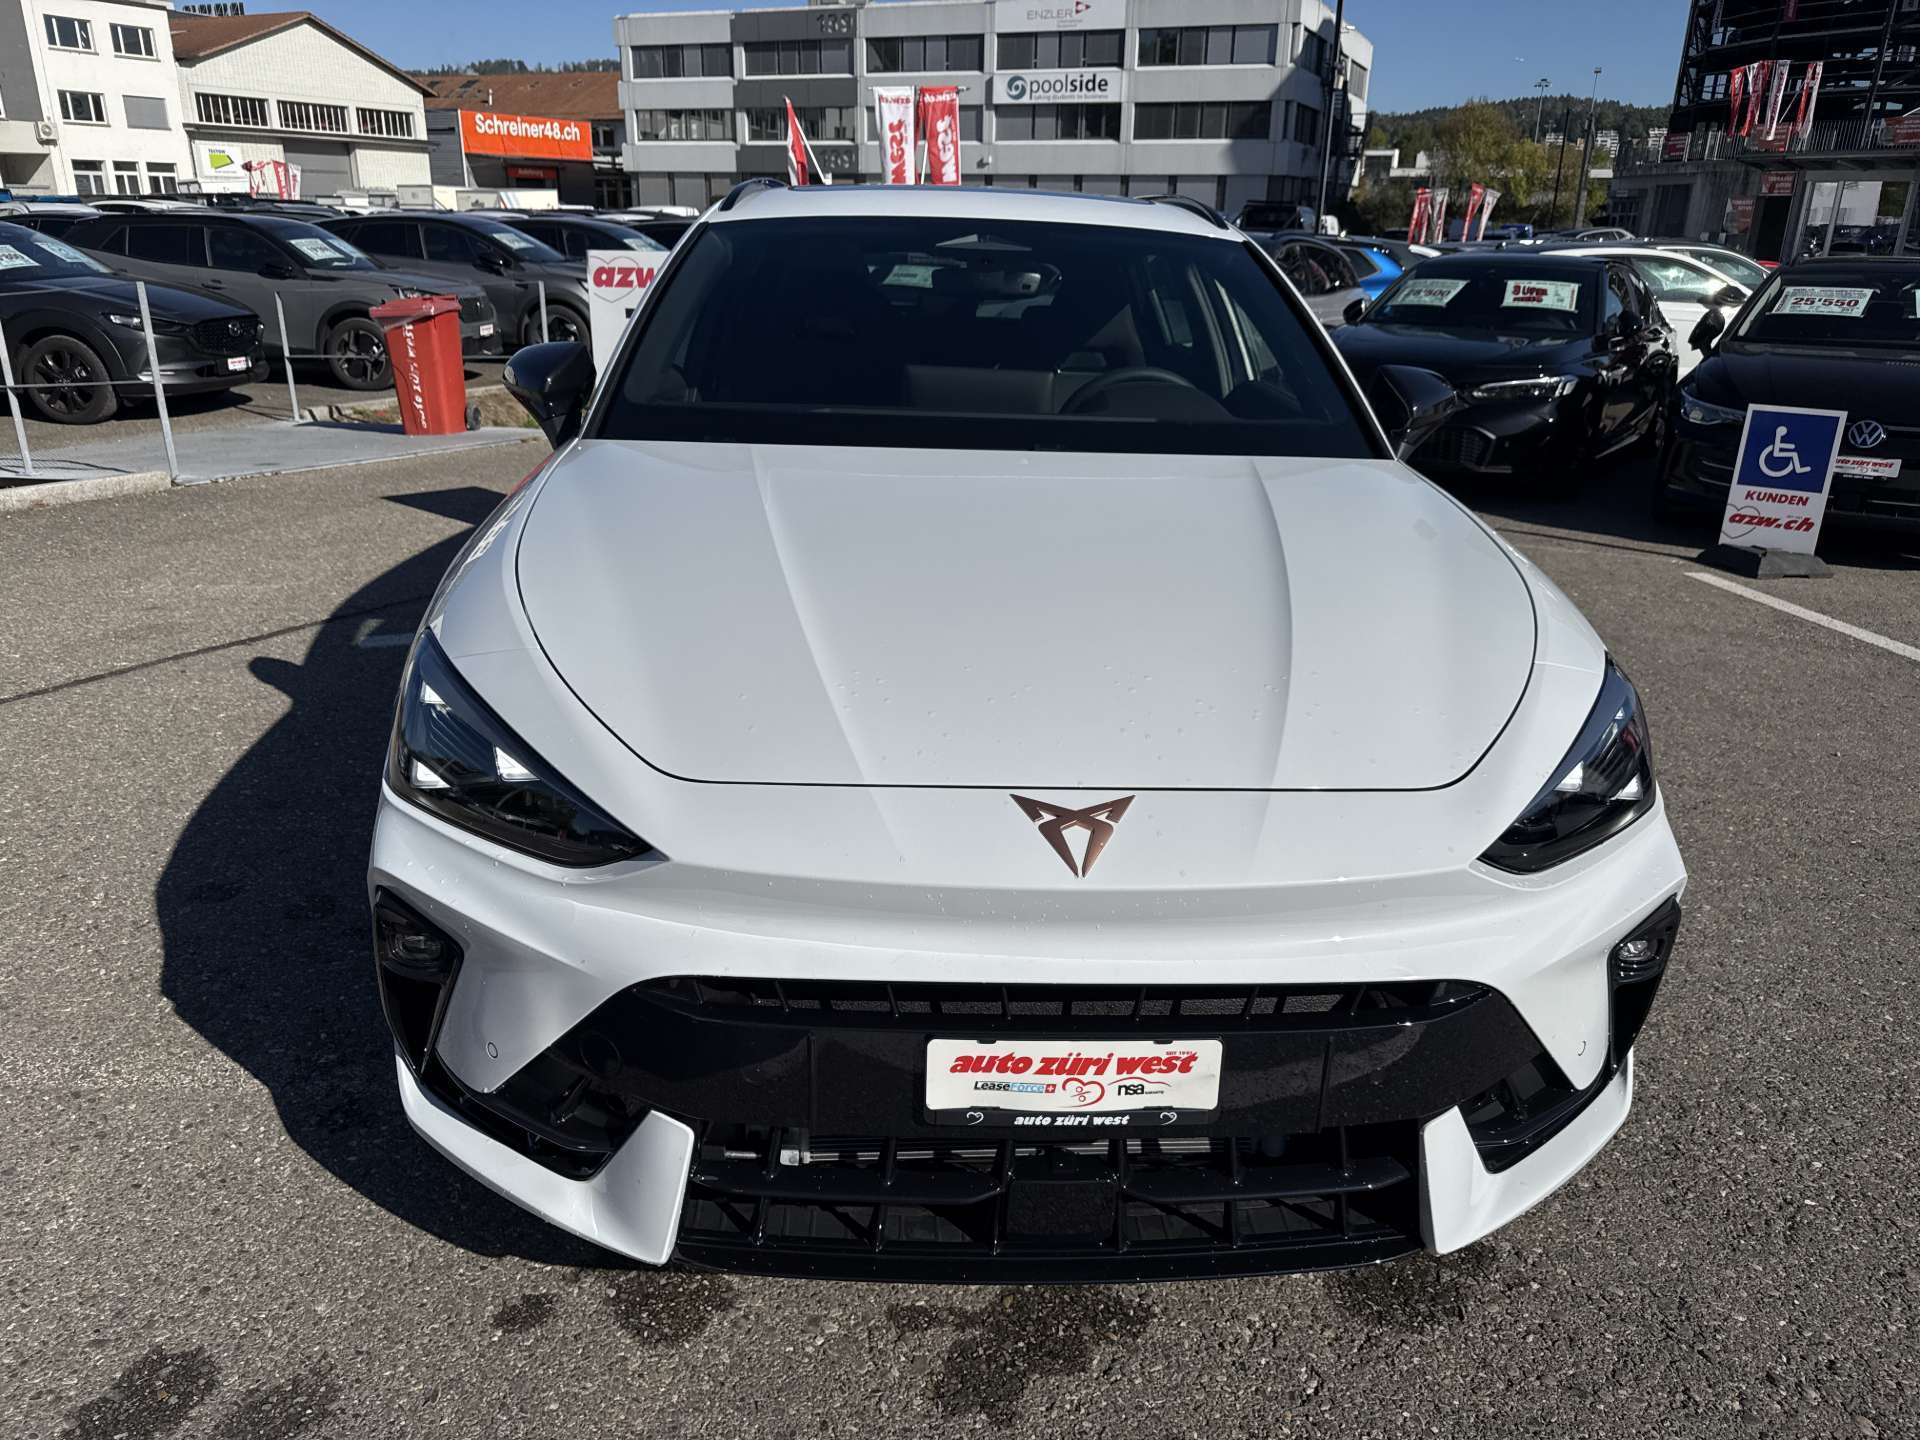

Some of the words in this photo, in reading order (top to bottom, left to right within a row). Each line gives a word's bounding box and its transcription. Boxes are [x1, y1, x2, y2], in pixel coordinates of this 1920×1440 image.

[1026, 9, 1074, 20] ENZLER
[1029, 74, 1109, 99] poolside
[475, 113, 580, 141] Schreiner48.ch
[1791, 297, 1860, 308] 25'550
[1745, 489, 1810, 507] KUNDEN
[1728, 512, 1815, 533] azw.ch
[949, 1052, 1033, 1075] auto
[1033, 1052, 1114, 1076] züri
[1116, 1052, 1198, 1076] west
[974, 1081, 1045, 1093] LeaseForce
[1117, 1083, 1145, 1096] nsa
[1014, 1114, 1051, 1126] auto
[1054, 1113, 1090, 1126] züri
[1093, 1113, 1130, 1126] west
